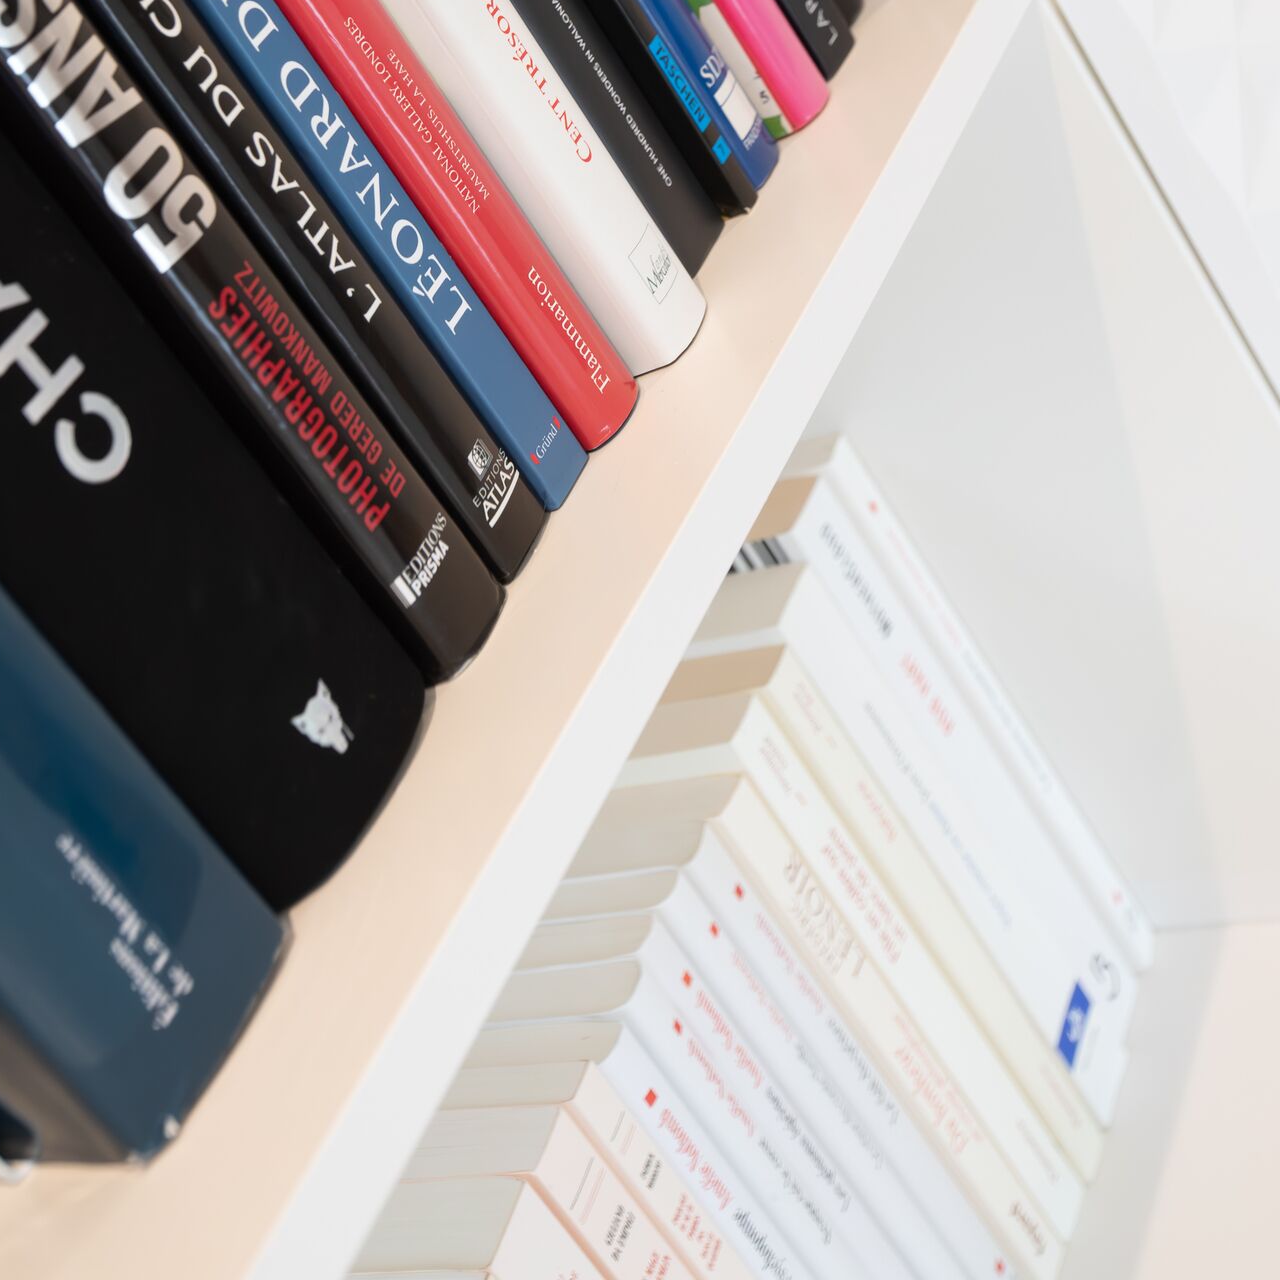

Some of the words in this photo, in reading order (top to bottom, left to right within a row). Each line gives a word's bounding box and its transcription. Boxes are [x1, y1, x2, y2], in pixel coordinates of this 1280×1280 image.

[342, 16, 393, 84] LONDRES
[386, 48, 414, 86] HAYE
[584, 49, 595, 63] IN
[651, 43, 710, 125] TASCHEN
[181, 44, 246, 127] DU
[387, 80, 434, 144] GALLERY,
[412, 85, 427, 106] LA
[591, 61, 628, 115] WONDERS
[425, 104, 490, 200] MAURITSHUIS,
[546, 95, 594, 164] CENT
[624, 113, 660, 164] HUNDRED
[88, 124, 220, 276] 50
[277, 57, 475, 338] LÉONARD
[430, 142, 481, 215] NATIONAL
[655, 163, 673, 188] ONE
[242, 129, 385, 323] L'ATLAS
[232, 260, 334, 394] MANKOWITZ
[524, 265, 612, 394] Flammarion
[205, 284, 393, 533] PHOTOGRAPHIES
[329, 390, 385, 465] GERED
[534, 422, 561, 459] Gründ
[378, 459, 408, 497] DE
[472, 447, 508, 507] EDITIONS
[480, 456, 516, 521] ATLAS
[397, 511, 448, 585] EDITIONS
[406, 539, 450, 597] PRISMA
[774, 849, 875, 983] LENOIR
